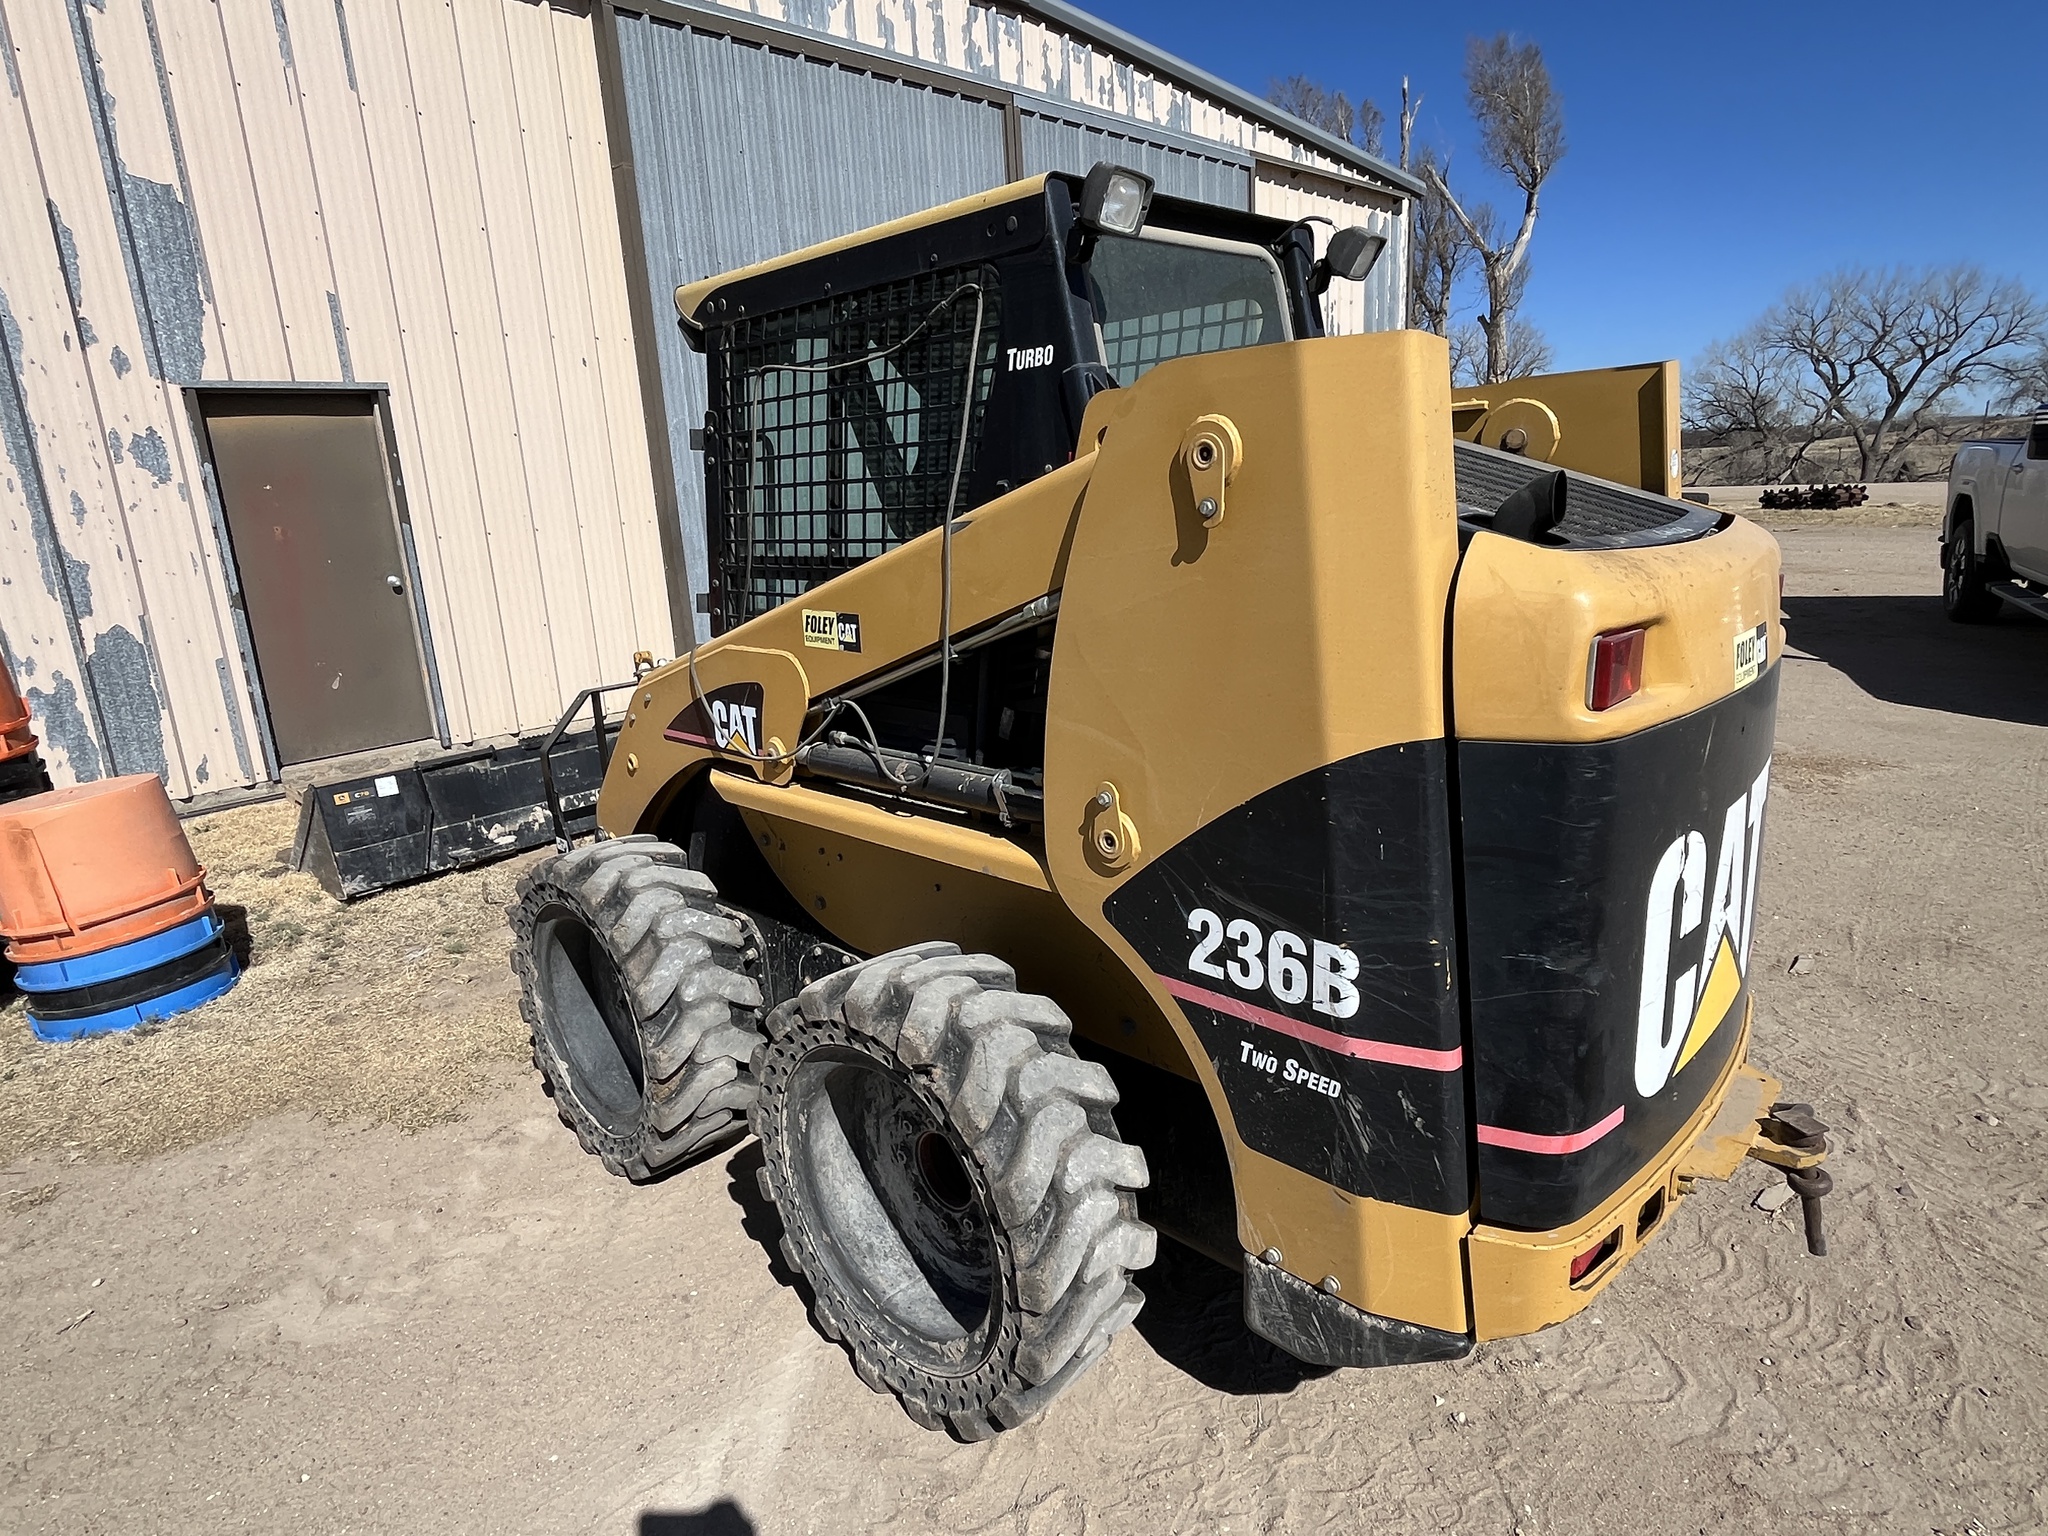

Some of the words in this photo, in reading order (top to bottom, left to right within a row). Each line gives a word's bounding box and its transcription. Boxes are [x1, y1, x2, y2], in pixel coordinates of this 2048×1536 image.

[1007, 344, 1054, 372] TURBO
[804, 614, 835, 636] FOLEY
[838, 622, 857, 643] CAT
[805, 634, 836, 645] EQUIPMENT
[712, 700, 757, 756] CAT
[1635, 753, 1772, 1098] CAT
[1187, 907, 1361, 1019] 236B
[1240, 1040, 1278, 1075] TWO
[1282, 1057, 1341, 1099] SPEED
